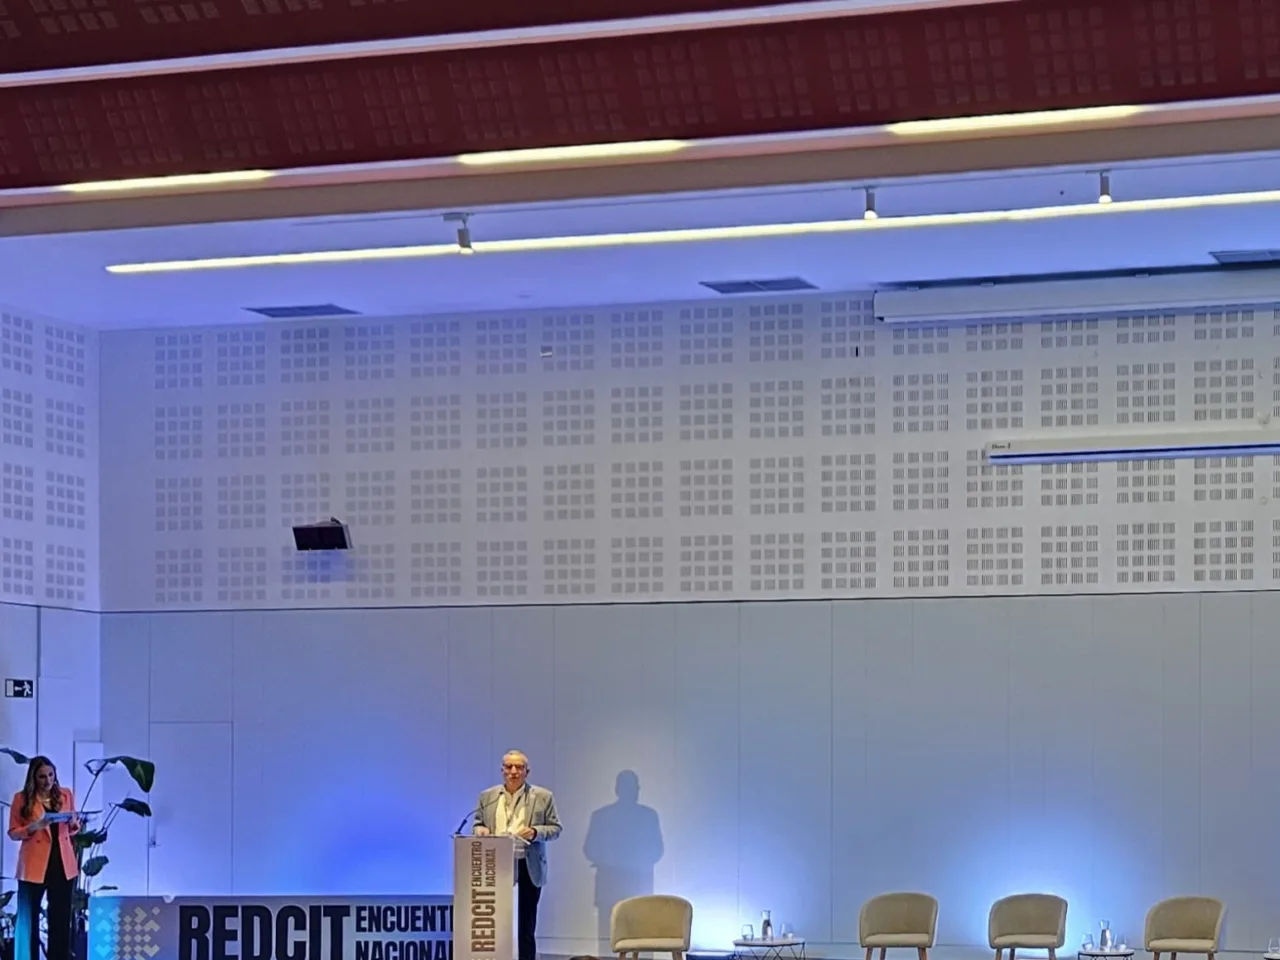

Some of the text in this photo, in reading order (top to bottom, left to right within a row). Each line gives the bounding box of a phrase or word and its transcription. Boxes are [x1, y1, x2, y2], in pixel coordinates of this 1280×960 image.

[471, 841, 482, 887] ENCUENTRO
[485, 848, 496, 887] NACIONAL
[355, 905, 453, 933] ENCUENT
[471, 888, 496, 952] REDCIT
